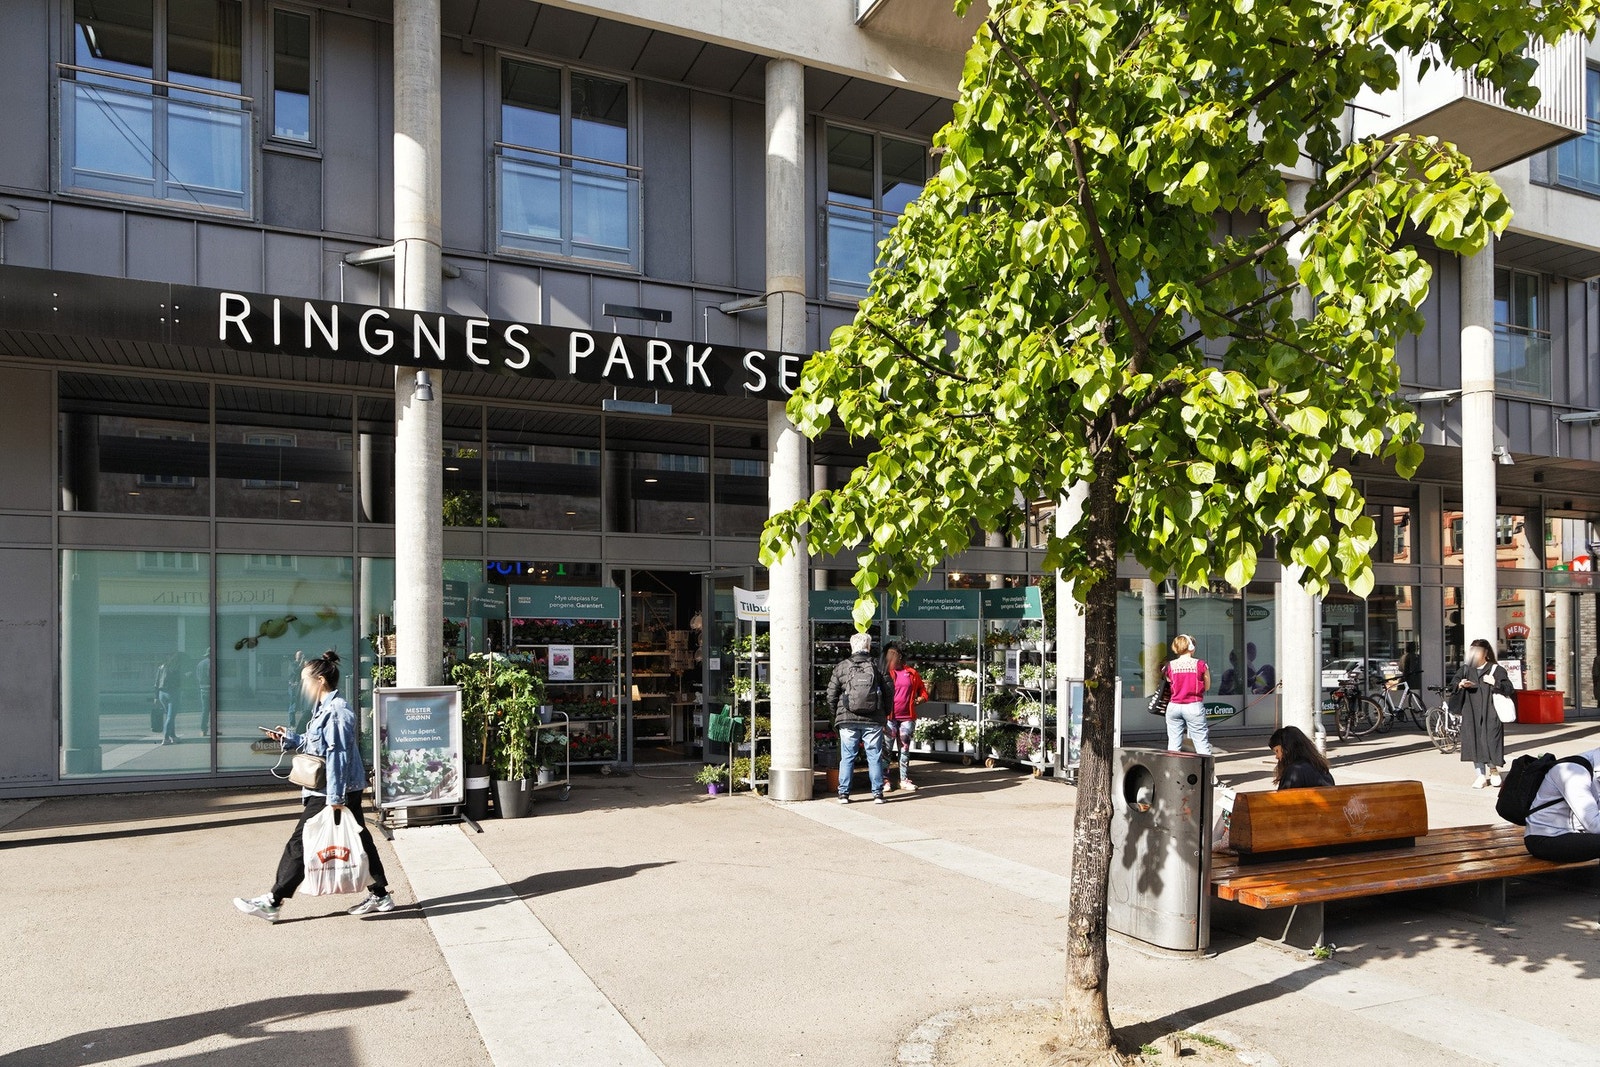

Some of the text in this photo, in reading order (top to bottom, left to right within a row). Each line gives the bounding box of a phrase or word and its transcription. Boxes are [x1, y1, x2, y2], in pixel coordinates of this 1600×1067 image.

[219, 292, 531, 370] RINGNES
[569, 331, 713, 388] PARK
[1507, 625, 1528, 636] MENY
[395, 735, 431, 743] Velkommen
